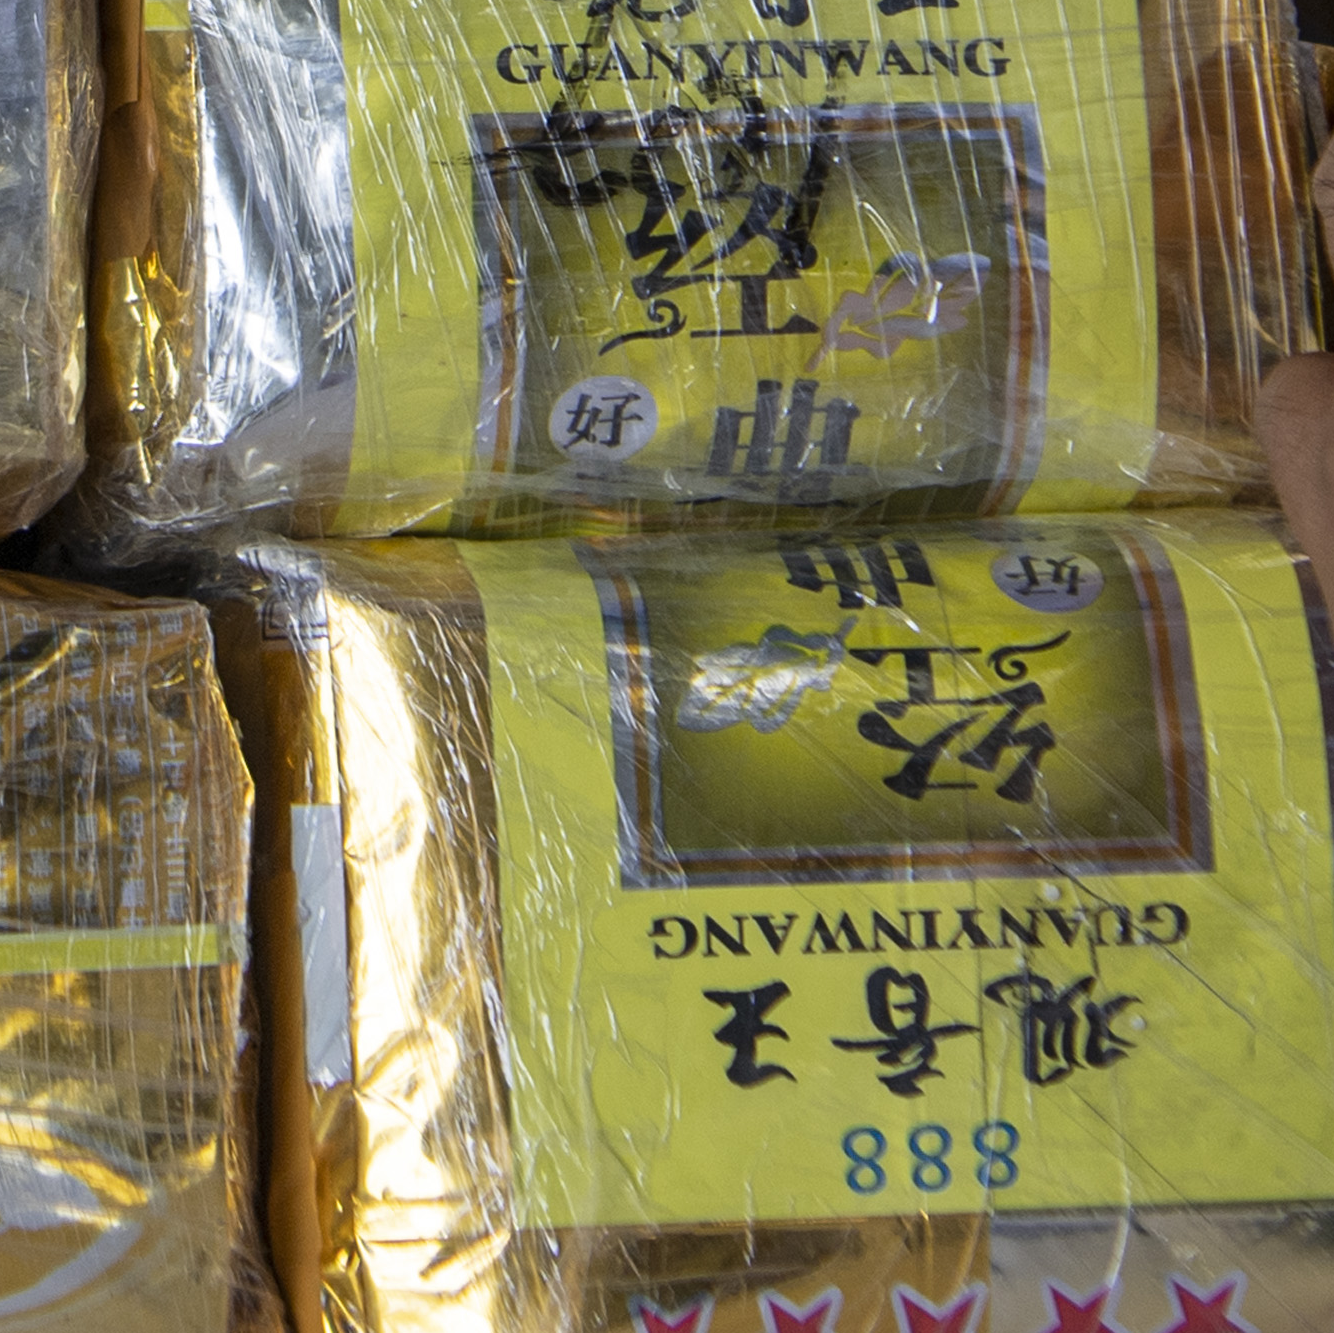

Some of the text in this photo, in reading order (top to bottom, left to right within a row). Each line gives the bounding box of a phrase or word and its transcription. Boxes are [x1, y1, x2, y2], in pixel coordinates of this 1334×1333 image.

[496, 36, 1011, 85] GUANYINWANG
[564, 393, 643, 448] 好
[648, 903, 1191, 961] GUANYINWANG
[704, 966, 1144, 1099] 观音王
[842, 1119, 1020, 1196] 888
